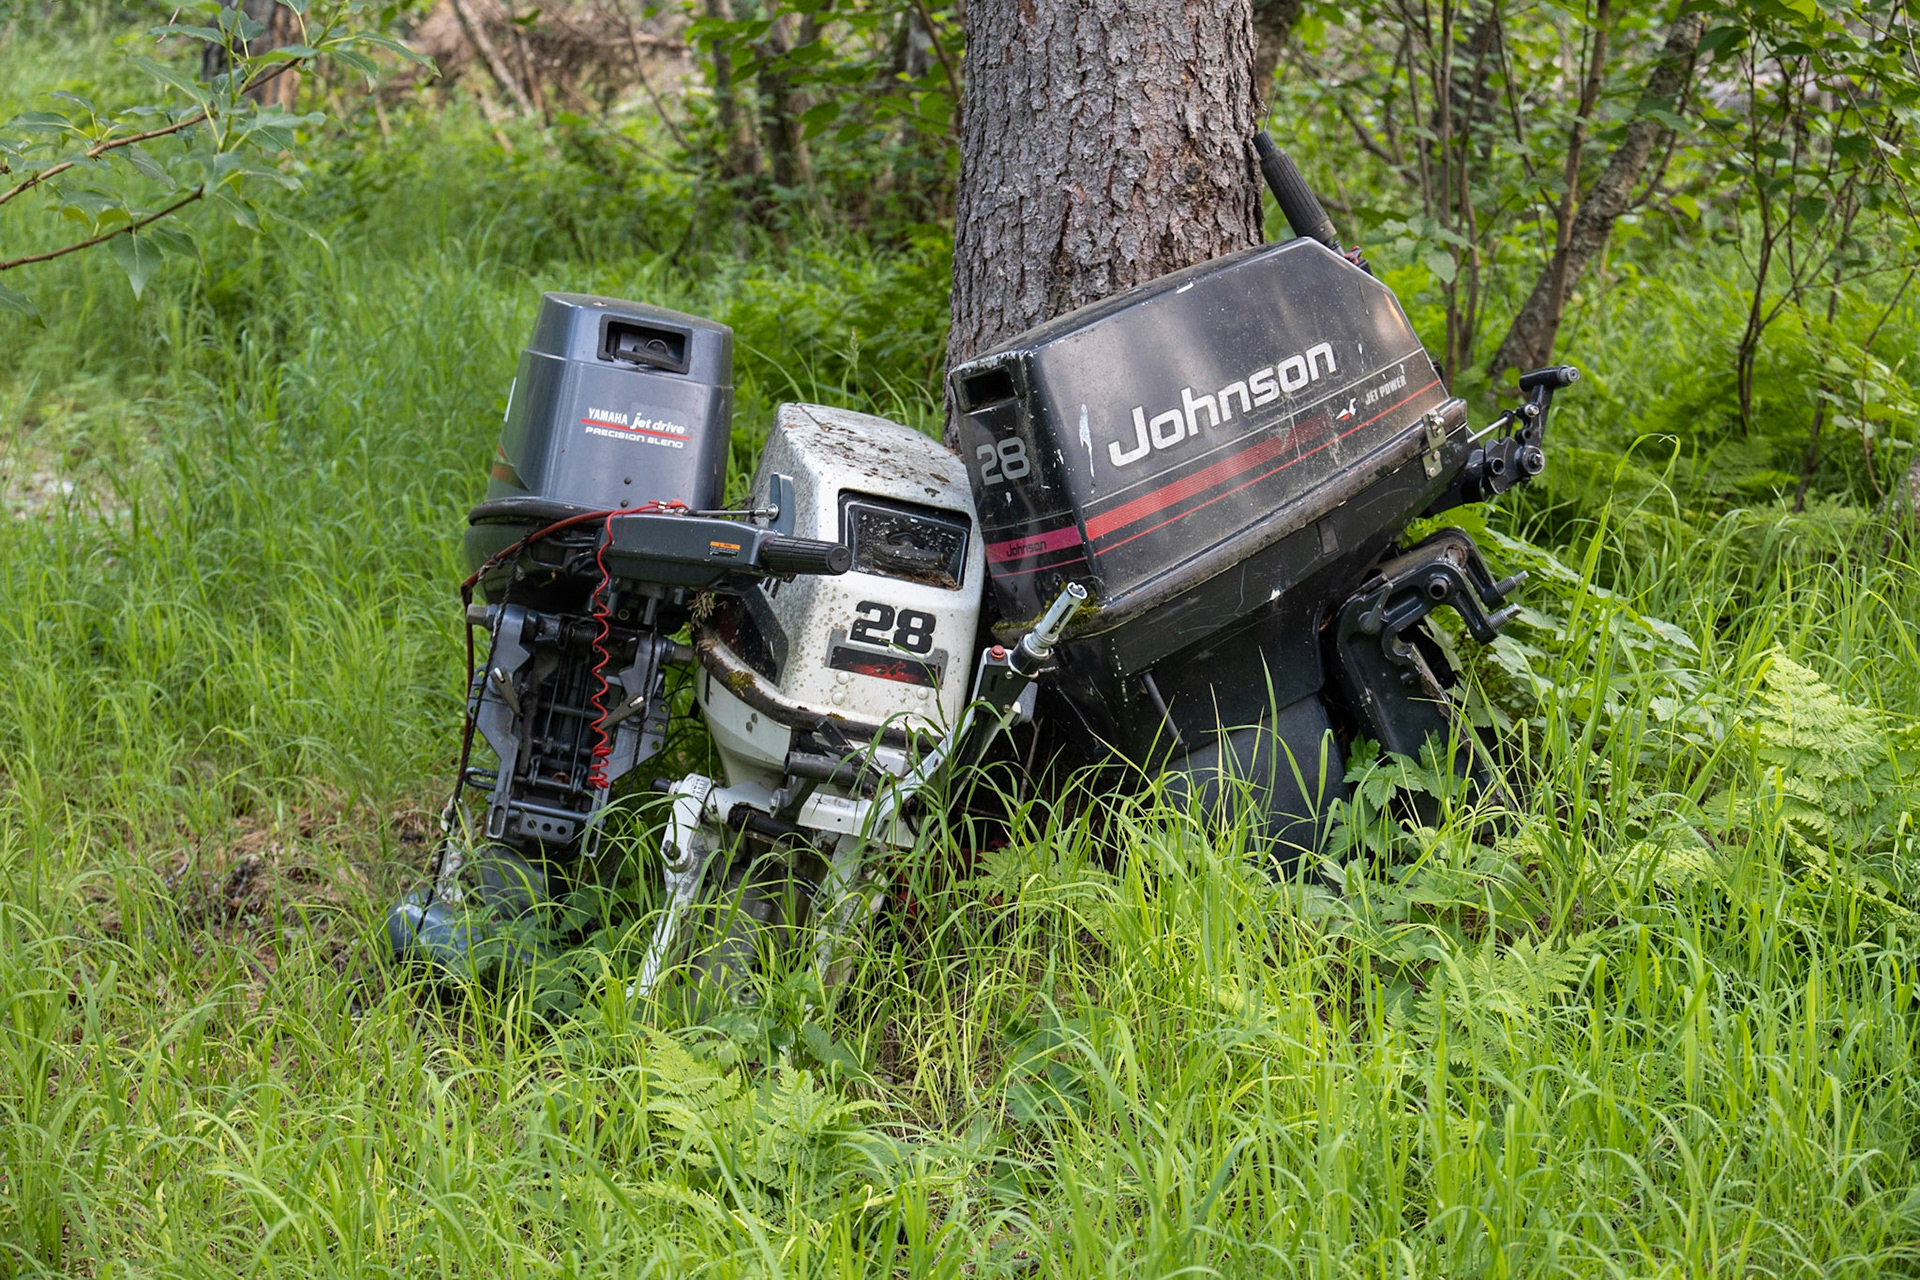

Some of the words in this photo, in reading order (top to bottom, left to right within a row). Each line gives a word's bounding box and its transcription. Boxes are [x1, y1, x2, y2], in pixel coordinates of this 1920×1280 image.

[1107, 341, 1338, 467] Johnson
[1365, 388, 1379, 405] JET
[1379, 375, 1407, 398] POWER
[588, 407, 628, 425] YAMAHA
[629, 412, 652, 430] jet
[652, 420, 685, 434] drive
[585, 426, 645, 442] PRECISION
[647, 436, 684, 449] BLEND
[976, 436, 1031, 486] 28
[1006, 541, 1047, 557] Johnson
[849, 600, 937, 654] 28
